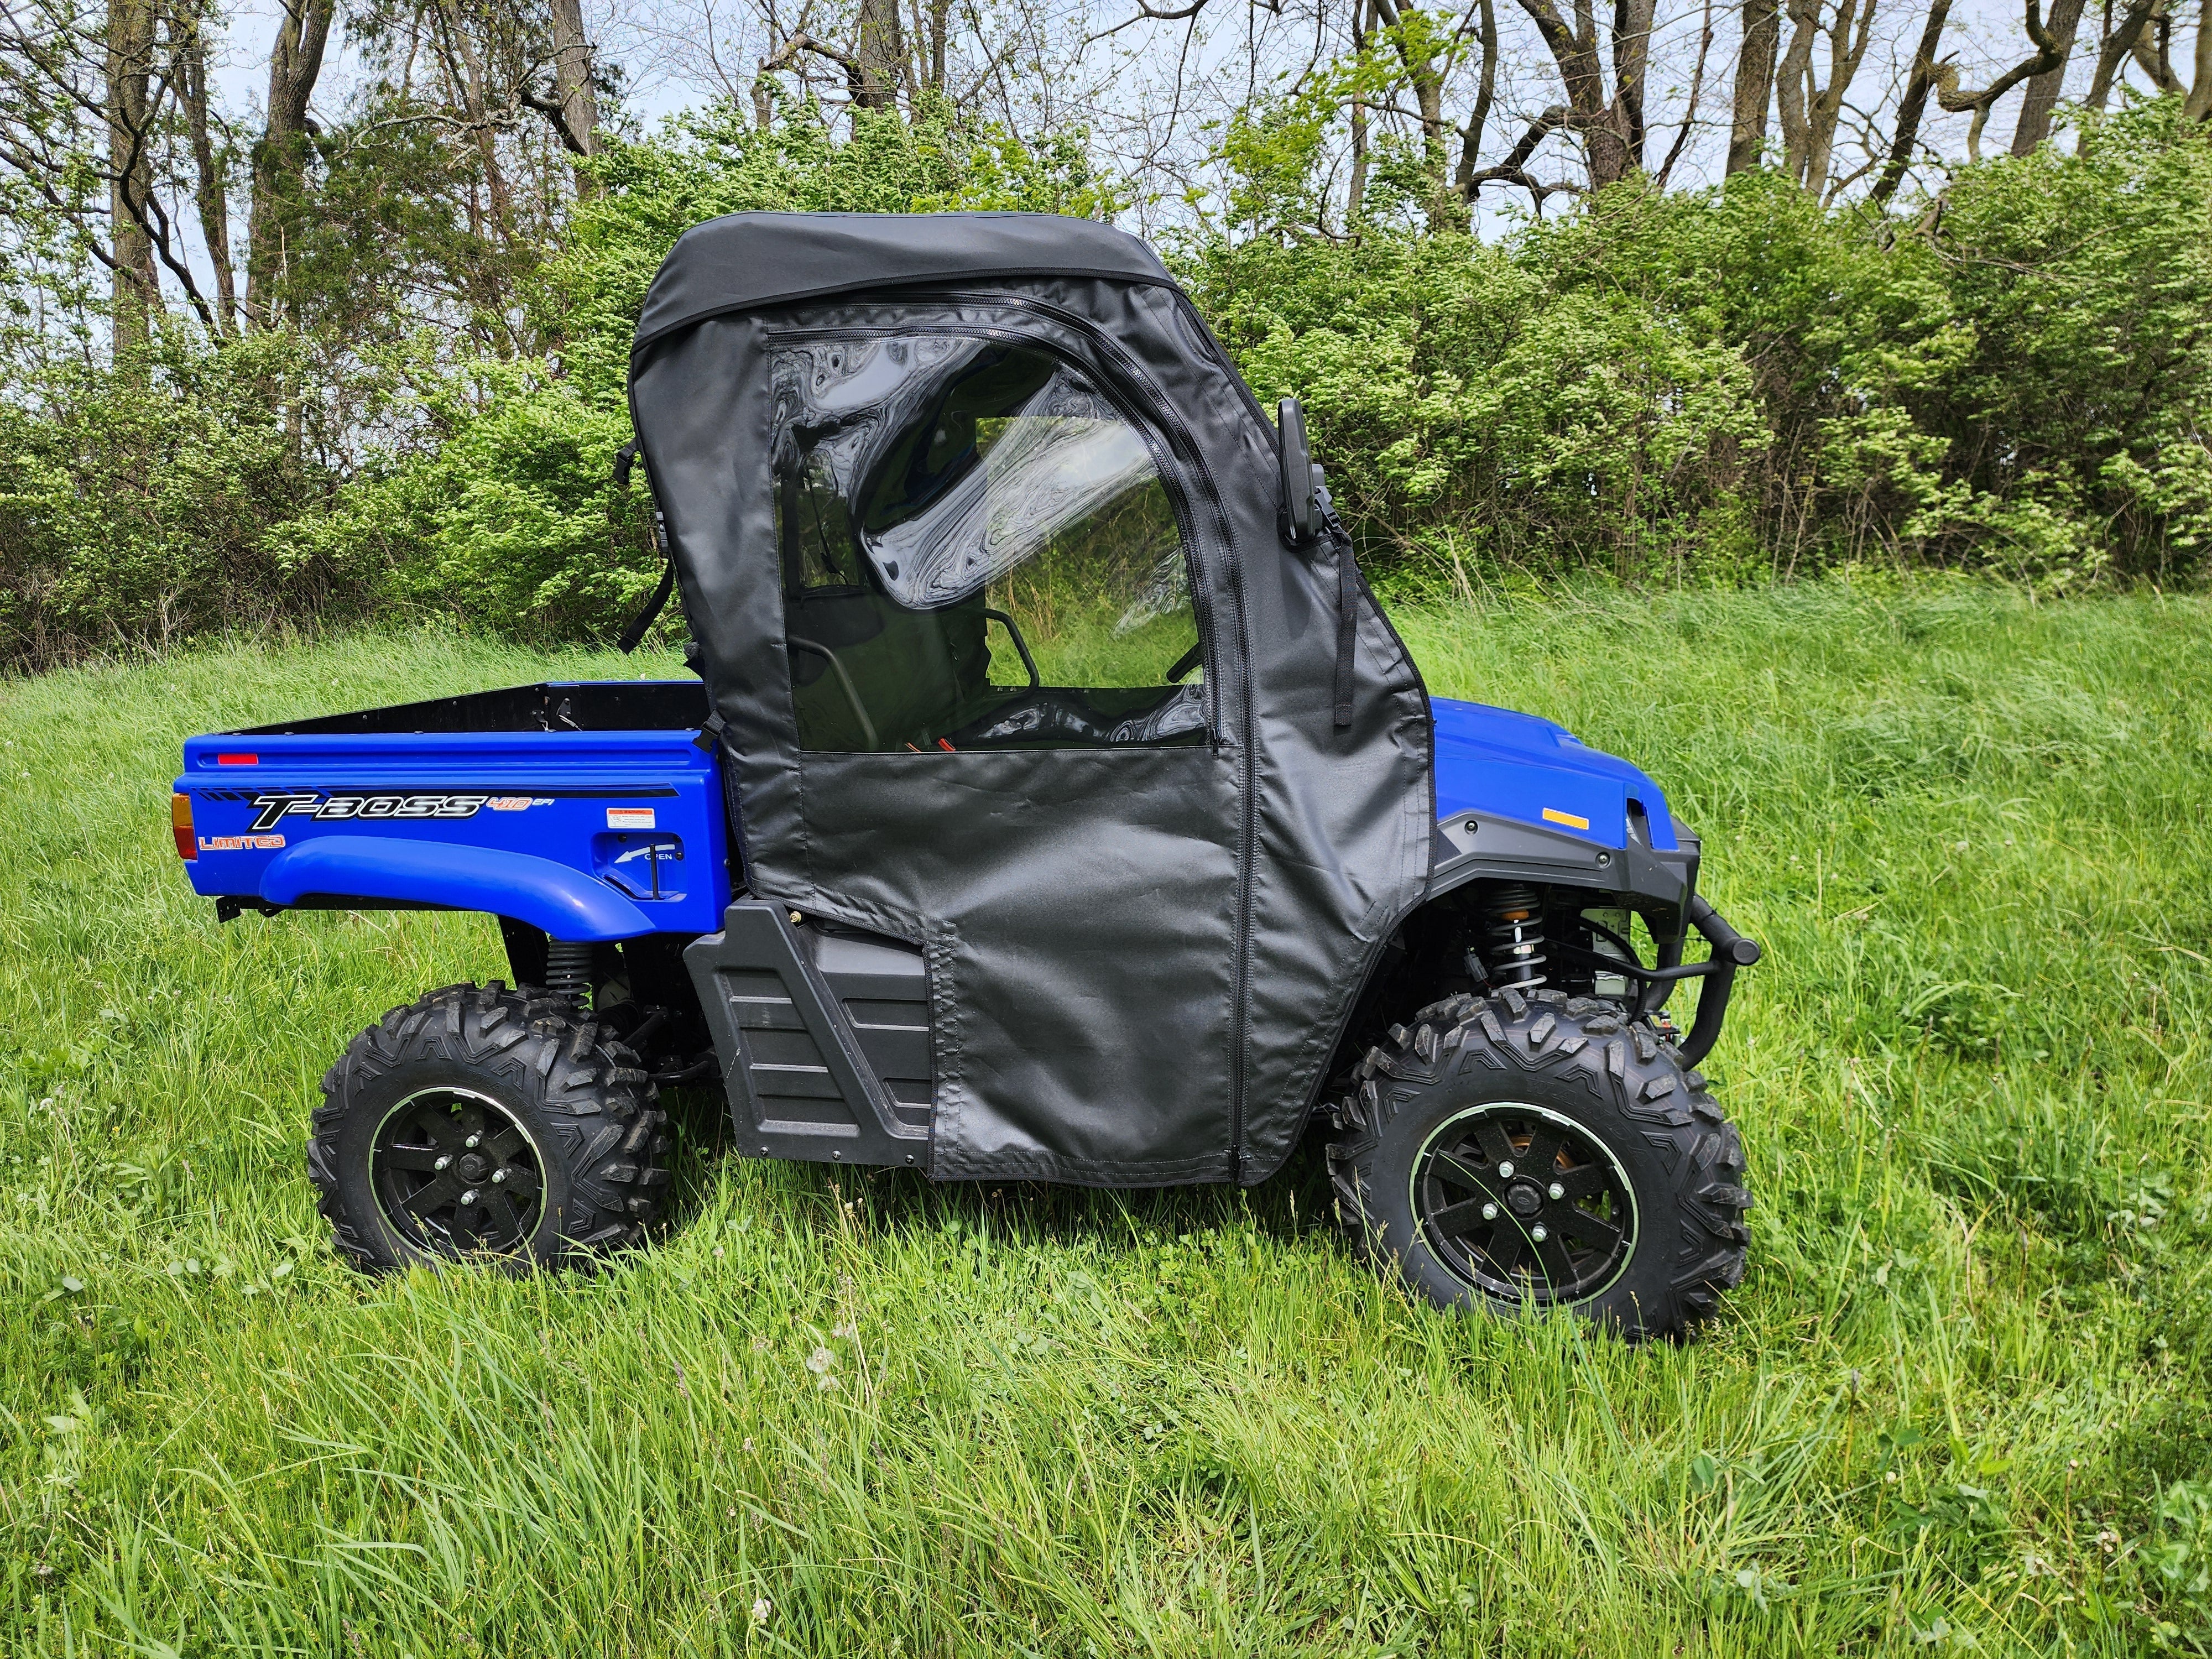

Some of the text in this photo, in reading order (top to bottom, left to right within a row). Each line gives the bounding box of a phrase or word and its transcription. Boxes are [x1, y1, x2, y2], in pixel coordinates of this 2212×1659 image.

[252, 794, 555, 830] T-BOSS 410 EFI
[198, 834, 286, 851] LIMITED
[466, 1068, 559, 1151] WANDA
